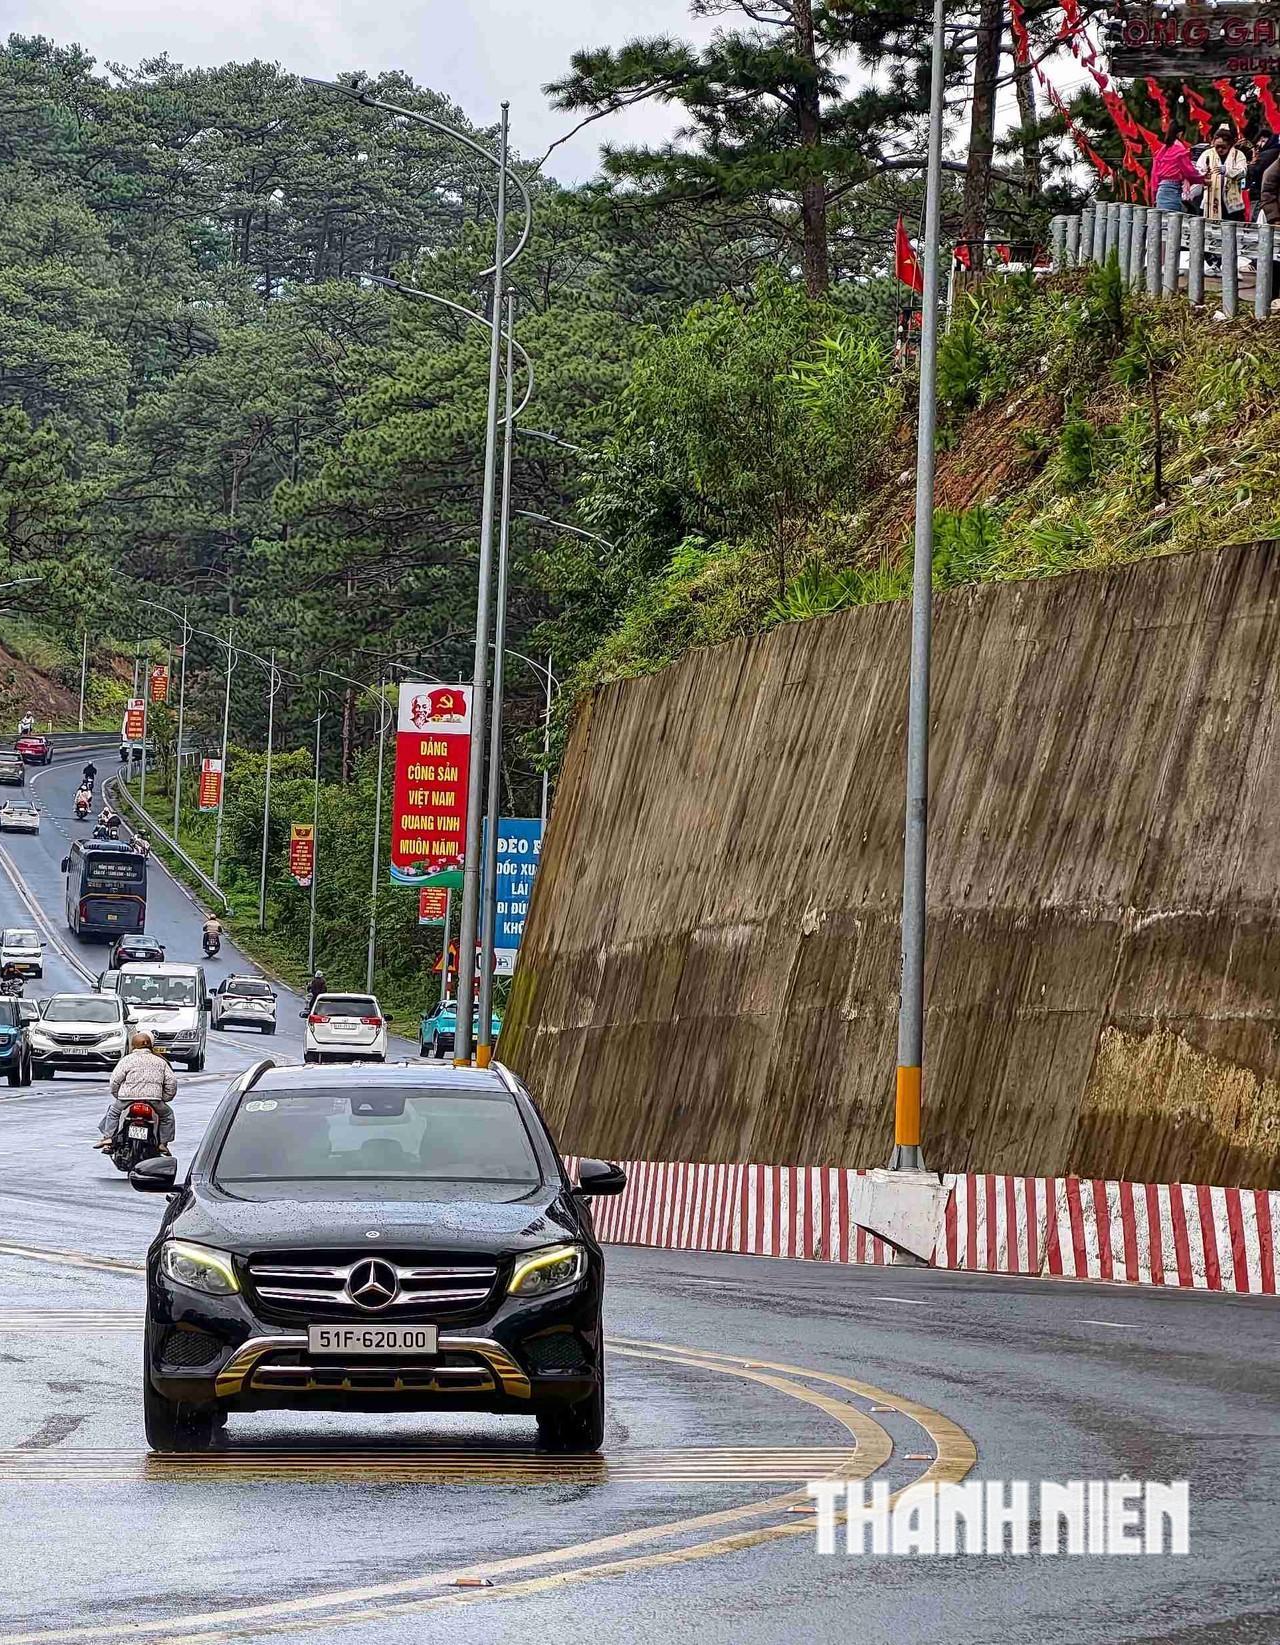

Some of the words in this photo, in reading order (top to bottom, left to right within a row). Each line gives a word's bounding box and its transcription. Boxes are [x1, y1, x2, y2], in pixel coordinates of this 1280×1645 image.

[420, 736, 448, 757] ĐẢNG
[407, 762, 435, 783] CỘNG
[437, 762, 458, 782] SẢN
[408, 788, 430, 808] VIỆT
[431, 790, 455, 807] NAM
[401, 814, 434, 831] QUANG
[437, 816, 460, 832] VINH
[399, 837, 429, 855] MUÔN
[431, 838, 459, 857] NĂM!
[497, 835, 529, 854] ĐÈO
[511, 882, 528, 896] LÁI
[497, 902, 508, 915] ĐI
[320, 1331, 426, 1348] 51F-620.00
